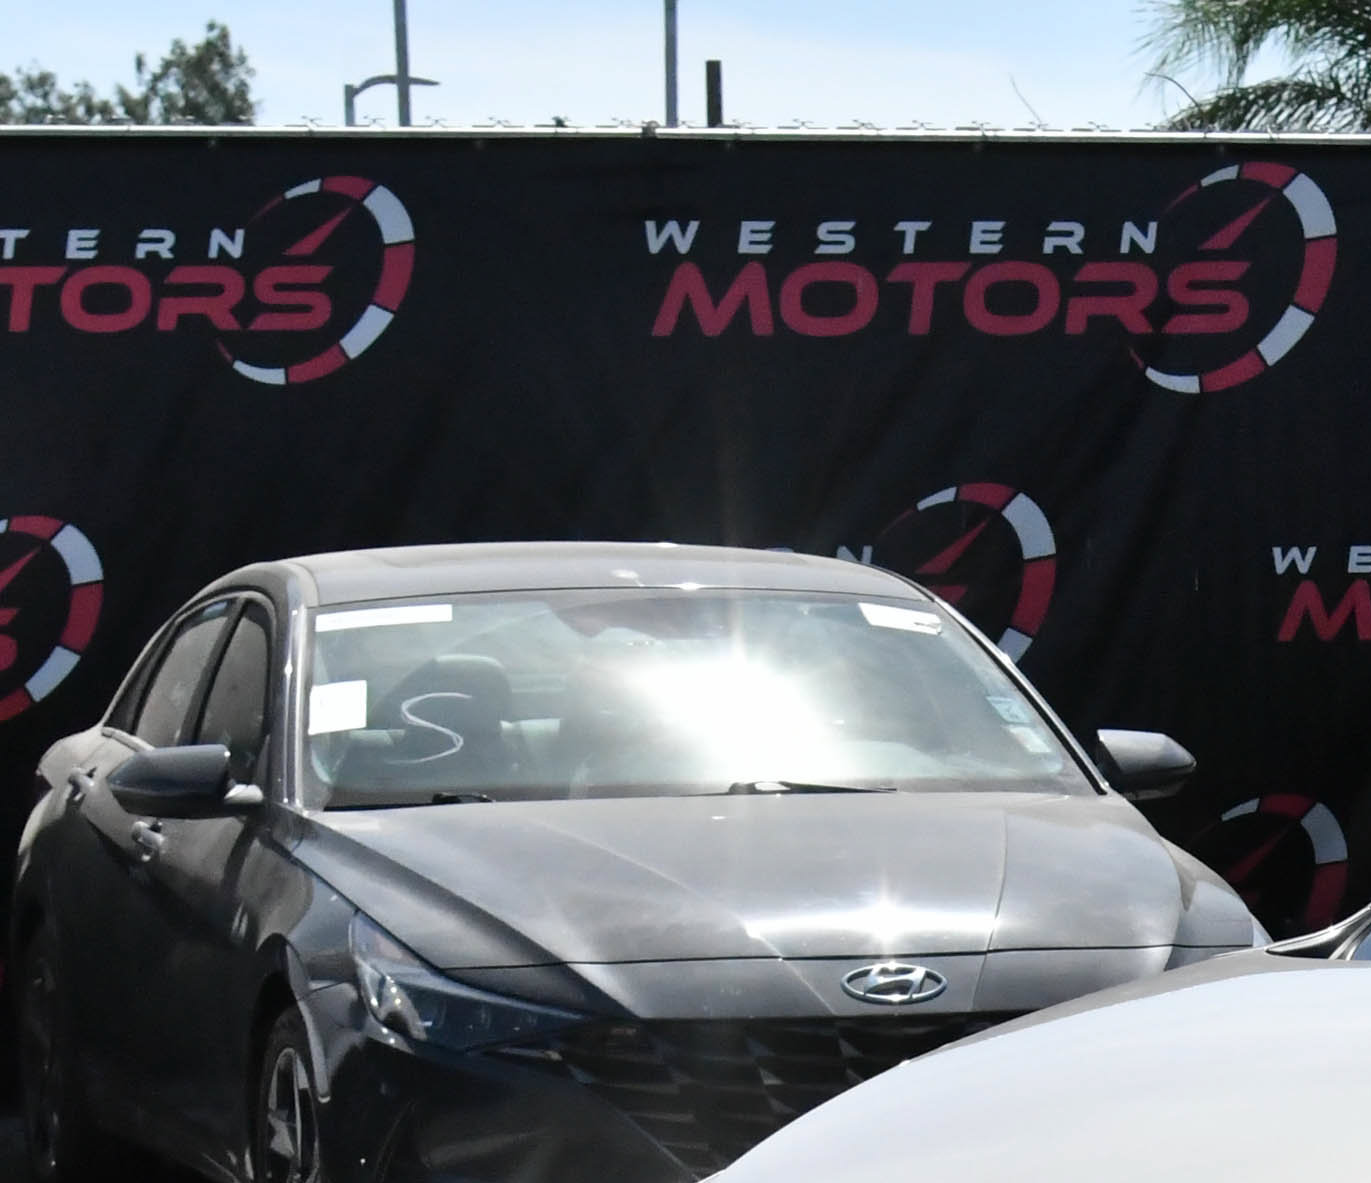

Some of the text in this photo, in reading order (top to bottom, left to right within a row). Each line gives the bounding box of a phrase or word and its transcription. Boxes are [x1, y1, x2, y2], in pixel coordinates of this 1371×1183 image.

[0, 228, 245, 260] TERN
[645, 220, 1158, 255] WESTERN
[0, 265, 333, 333] TORS
[652, 261, 1250, 337] MOTORS
